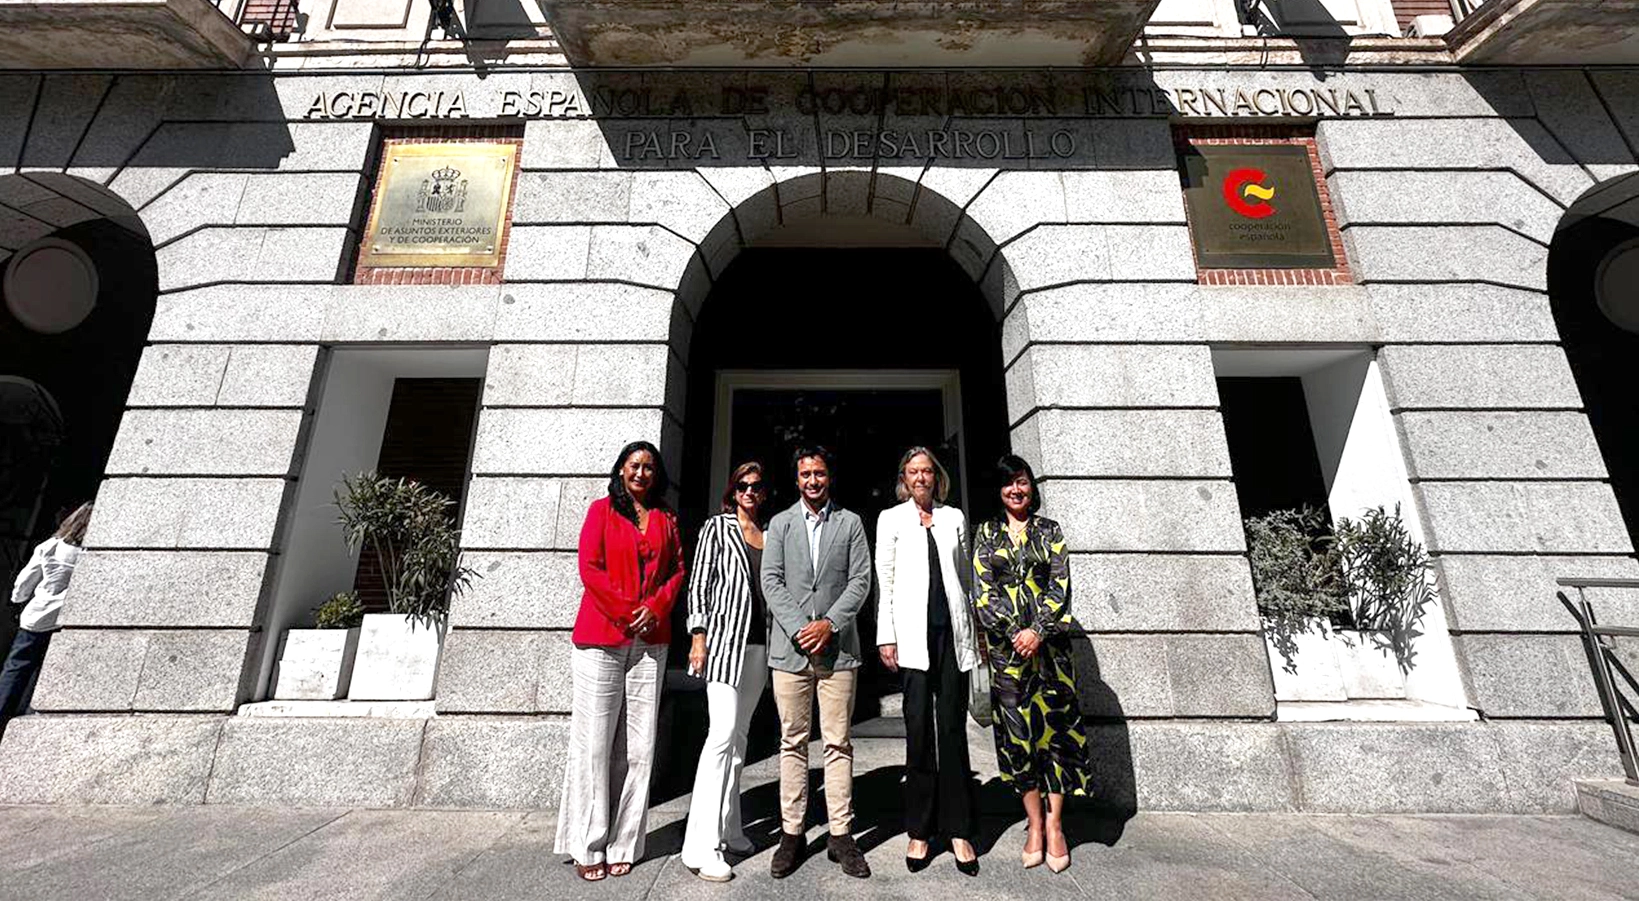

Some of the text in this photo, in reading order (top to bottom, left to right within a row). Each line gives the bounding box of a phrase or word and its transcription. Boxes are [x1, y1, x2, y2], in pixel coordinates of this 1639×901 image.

[303, 90, 470, 119] AGENCIA
[721, 86, 770, 115] DE
[1083, 88, 1396, 117] INTERNACIONAL
[623, 129, 1077, 160] PARA EL DESARROLLO
[412, 218, 463, 226] MINISTERIO
[380, 227, 492, 235] DE ASUNTOS EXTERIORES
[388, 236, 396, 244] Y
[397, 236, 409, 244] DE
